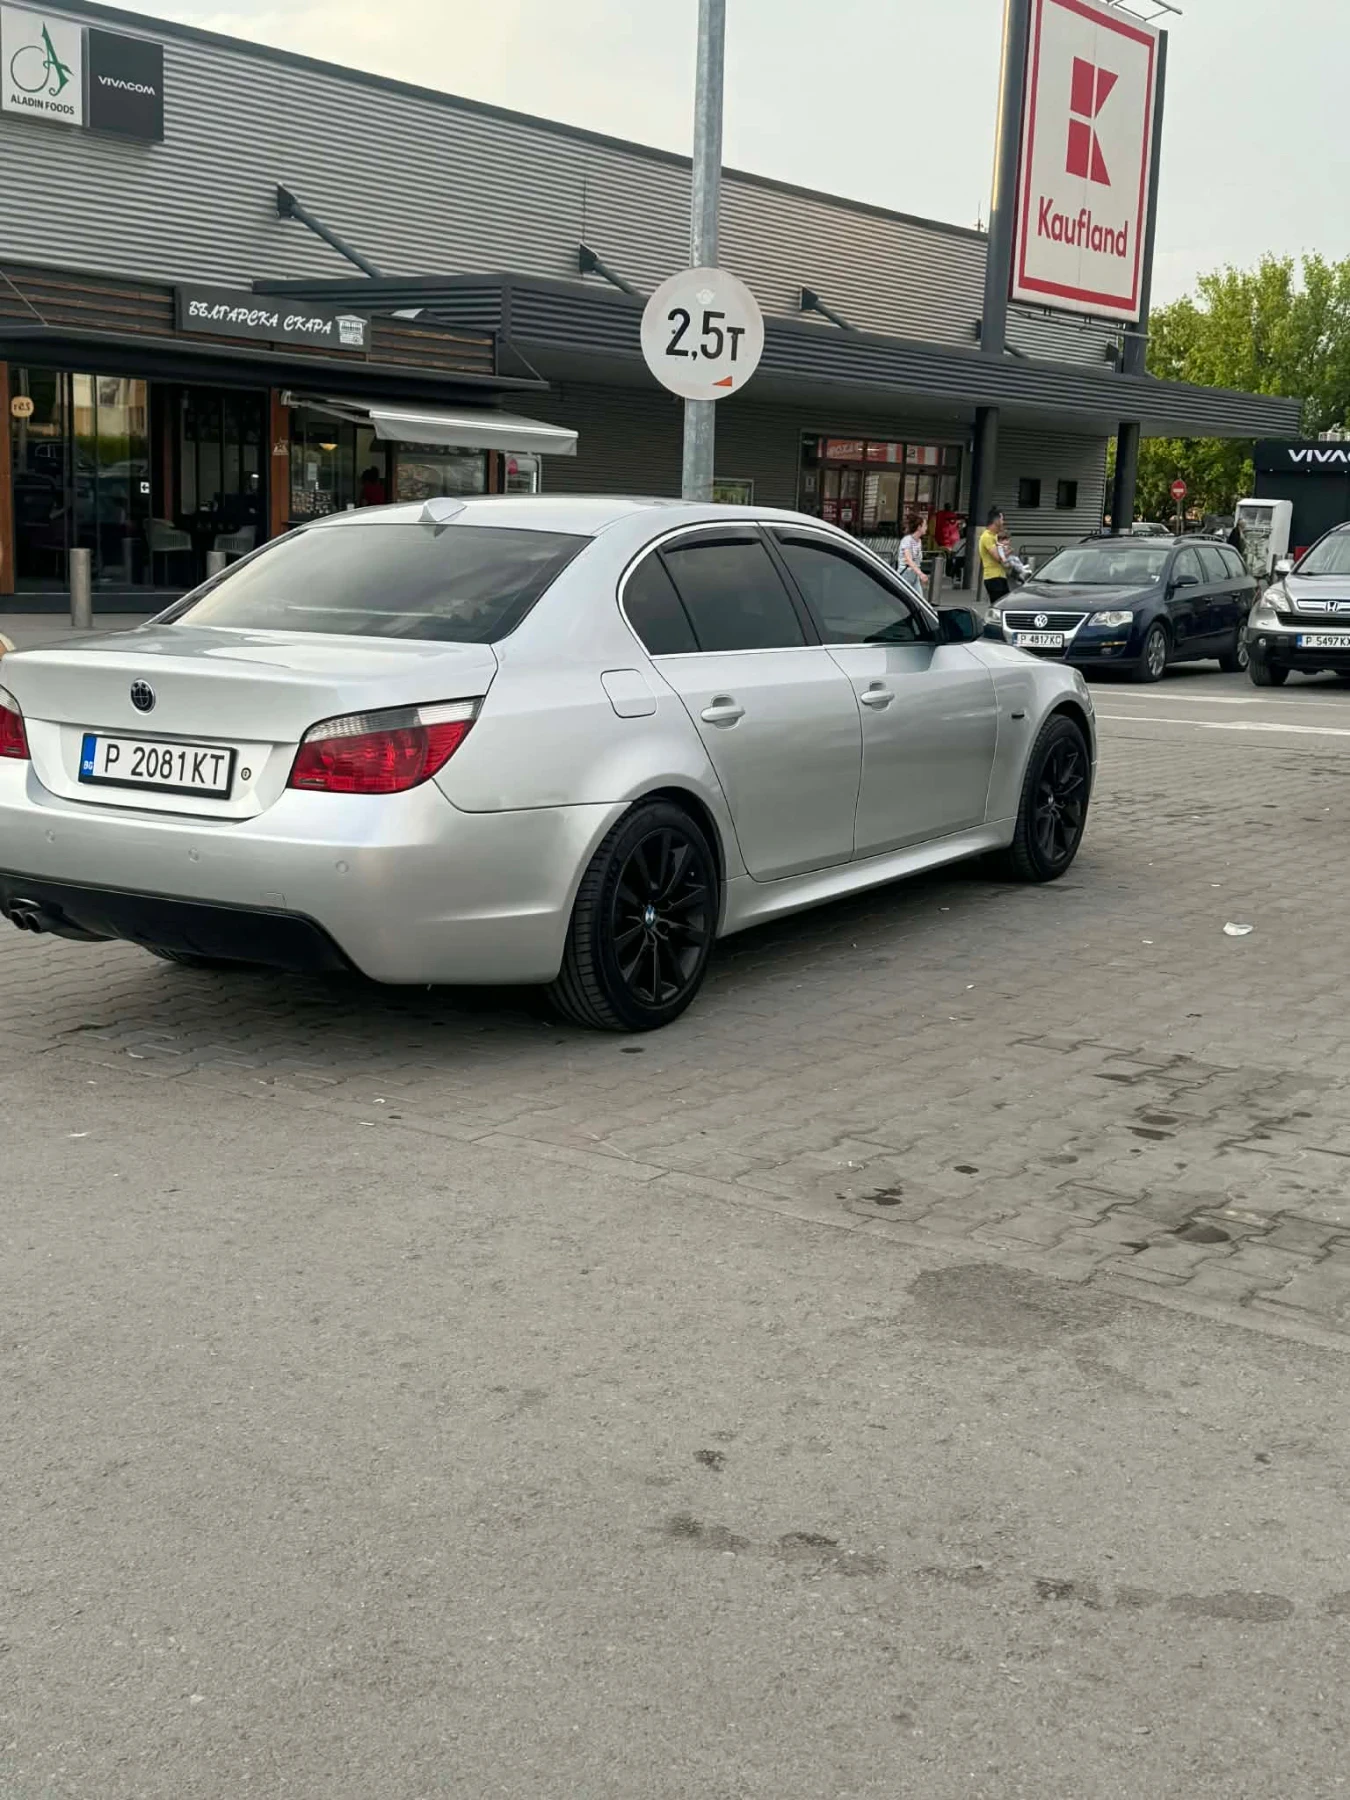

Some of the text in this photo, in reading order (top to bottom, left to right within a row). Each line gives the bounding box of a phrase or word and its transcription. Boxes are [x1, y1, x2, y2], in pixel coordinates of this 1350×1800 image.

[98, 75, 156, 96] VIVACOM
[11, 94, 75, 115] ALADIN FOODS
[1066, 56, 1119, 187] K
[1037, 196, 1129, 258] Kaufland
[188, 301, 333, 335] БЪЛГАРСКА СКАРА
[1288, 449, 1350, 463] VIVA
[1306, 636, 1312, 646] P
[104, 743, 120, 773] P
[130, 746, 225, 785] 2081KT
